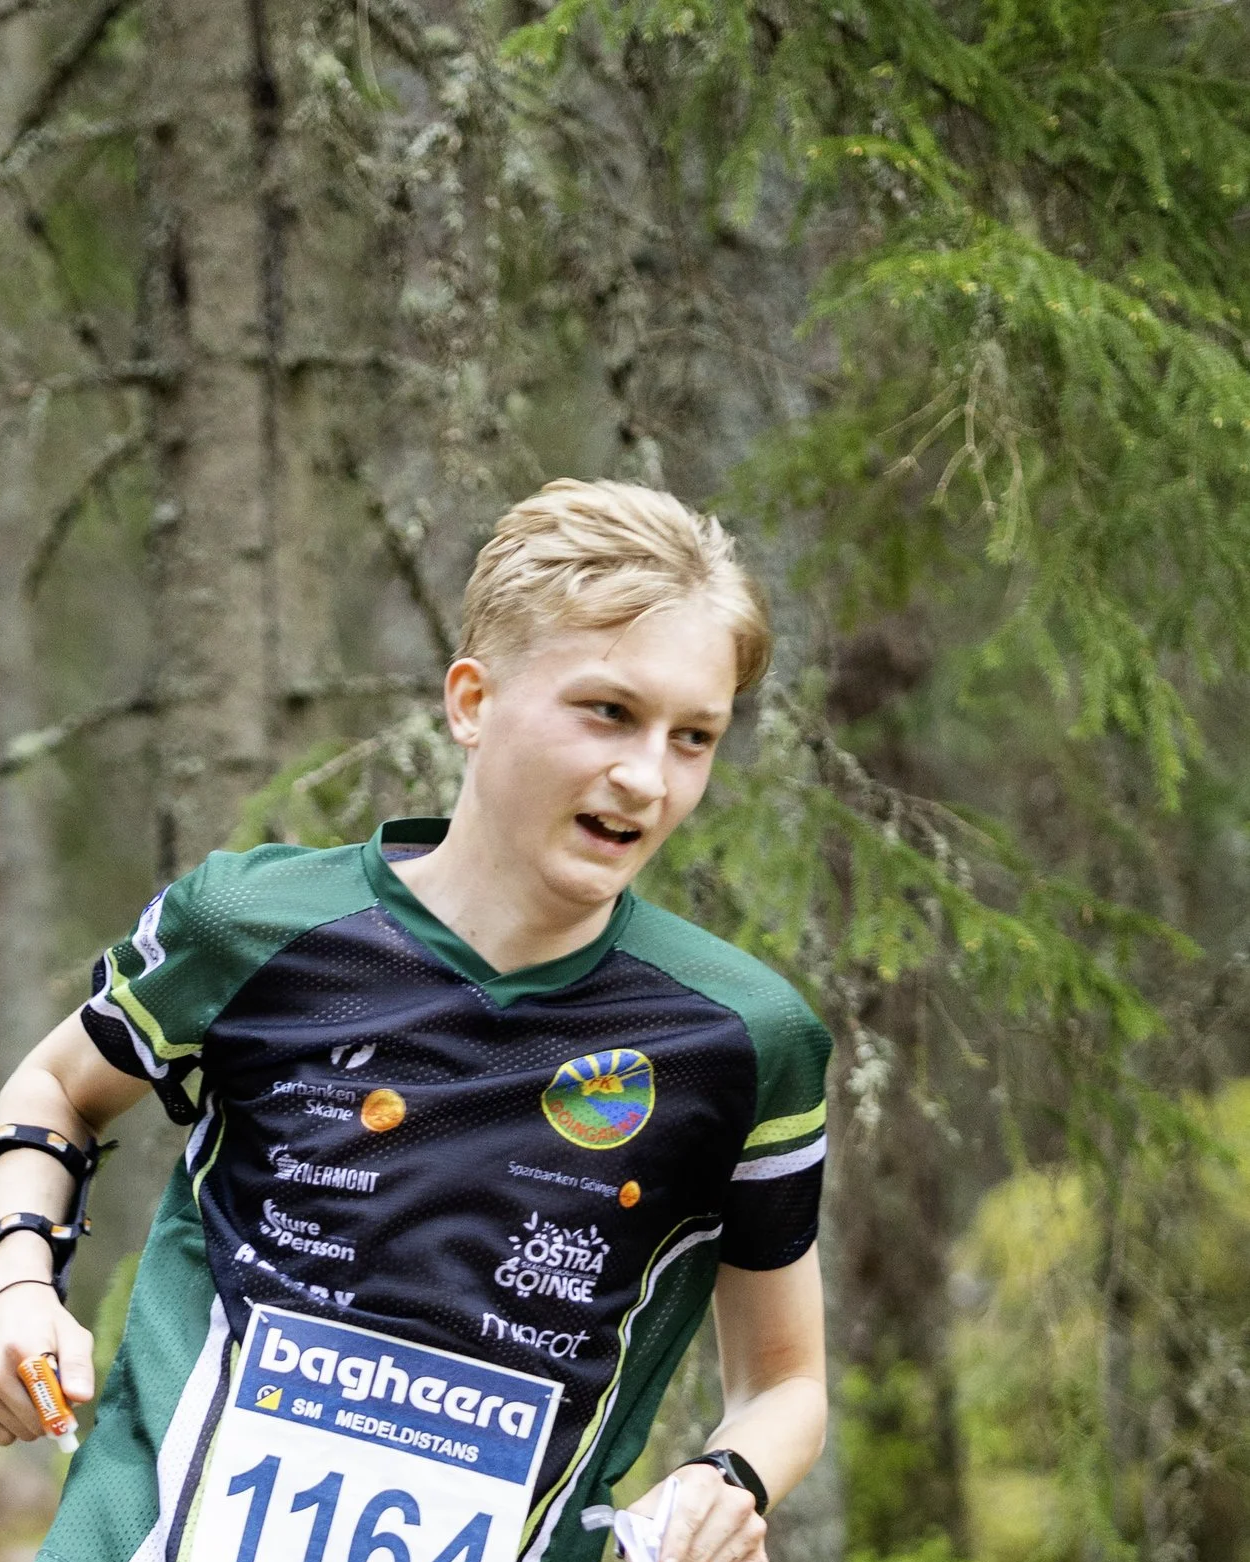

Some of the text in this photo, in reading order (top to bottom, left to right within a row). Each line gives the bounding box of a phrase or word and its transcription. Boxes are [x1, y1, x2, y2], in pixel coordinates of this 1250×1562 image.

[507, 1160, 579, 1187] Sparbanken
[277, 1231, 356, 1262] Persson
[524, 1232, 604, 1274] ÖSTRA
[494, 1262, 597, 1304] GÖINGE
[259, 1328, 539, 1440] bagheera
[291, 1398, 480, 1464] SM MEDELDISTANS
